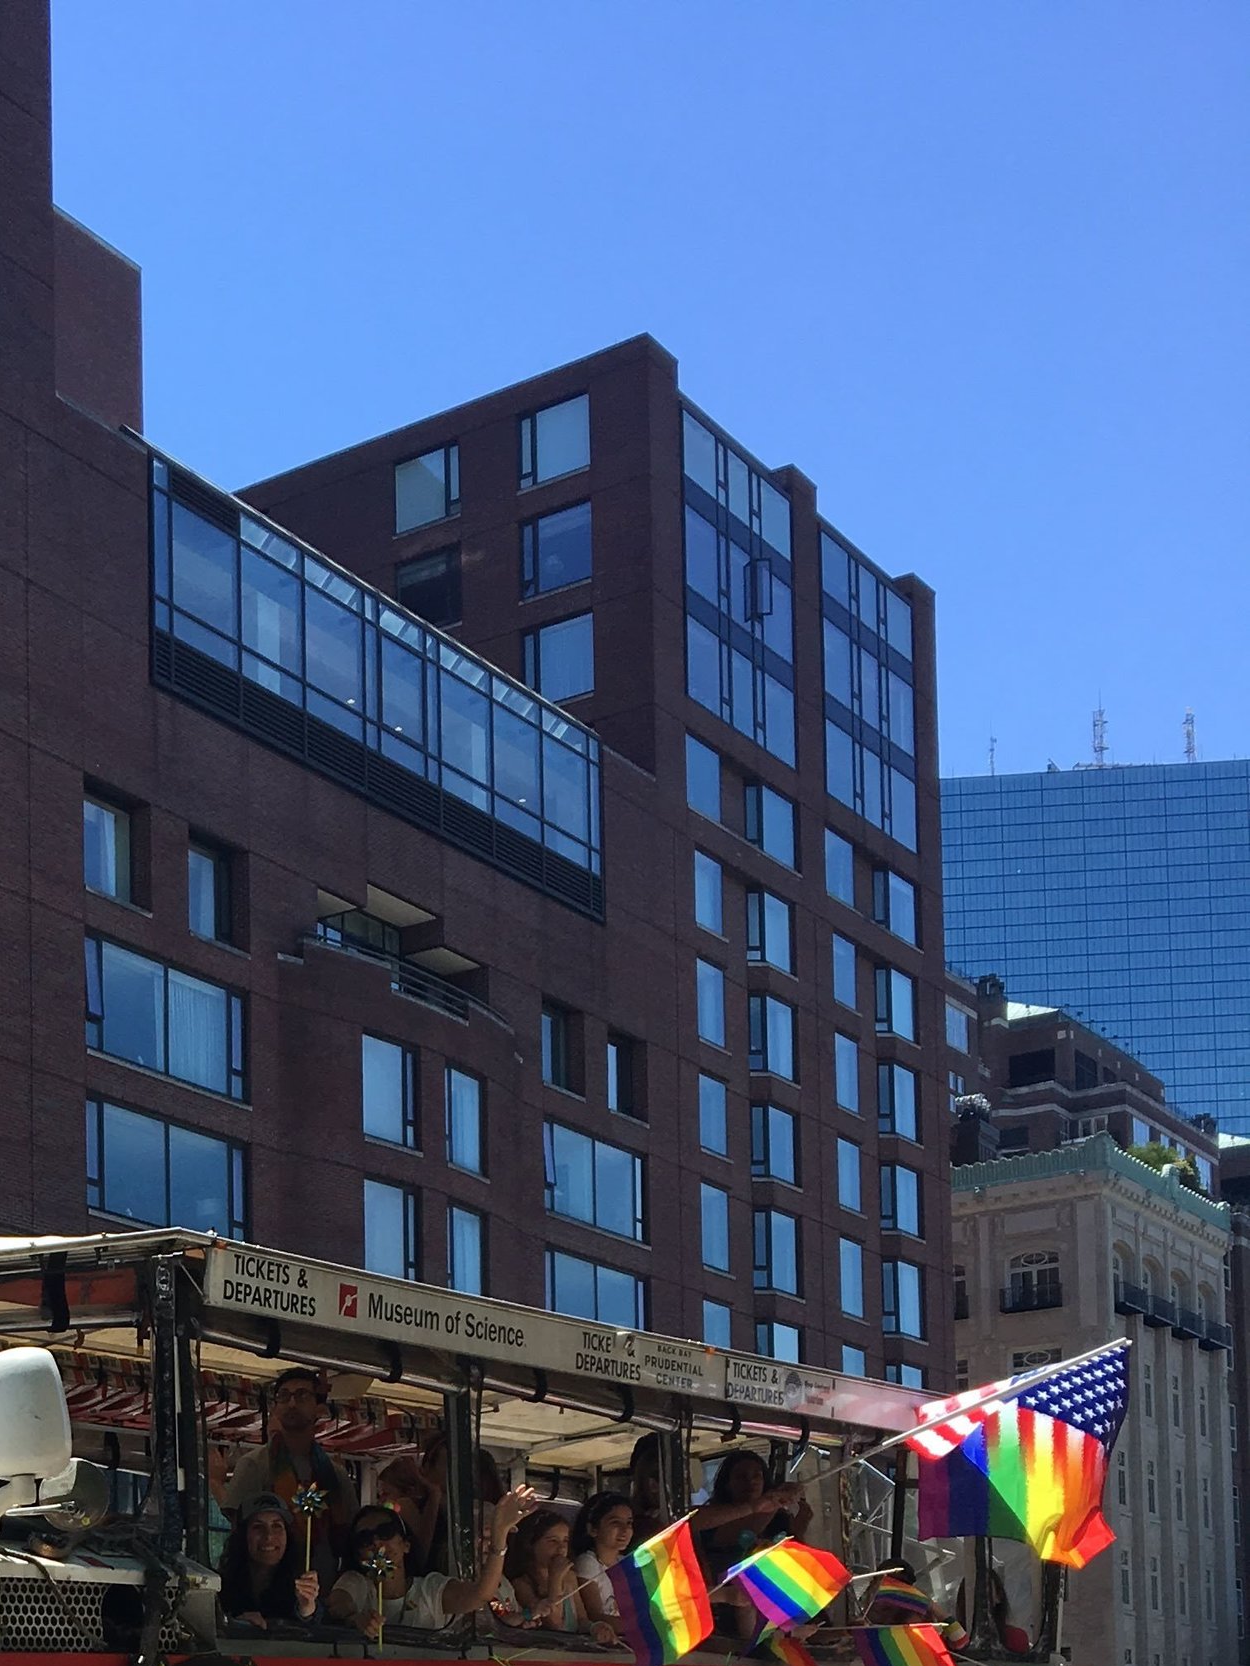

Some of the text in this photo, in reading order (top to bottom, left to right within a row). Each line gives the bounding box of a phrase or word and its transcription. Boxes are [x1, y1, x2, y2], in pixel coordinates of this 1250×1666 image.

[234, 1254, 308, 1288] TICKETS &
[223, 1280, 316, 1317] DEPARTURES
[368, 1293, 439, 1331] Museum
[444, 1311, 462, 1335] of
[582, 1332, 614, 1353] TICKE
[576, 1353, 641, 1381] DEPARTURES
[644, 1355, 704, 1377] PRUDENTIAL
[733, 1362, 778, 1384] TICKETS &
[655, 1373, 693, 1389] CENTER
[727, 1382, 784, 1406] DEPARTURES
